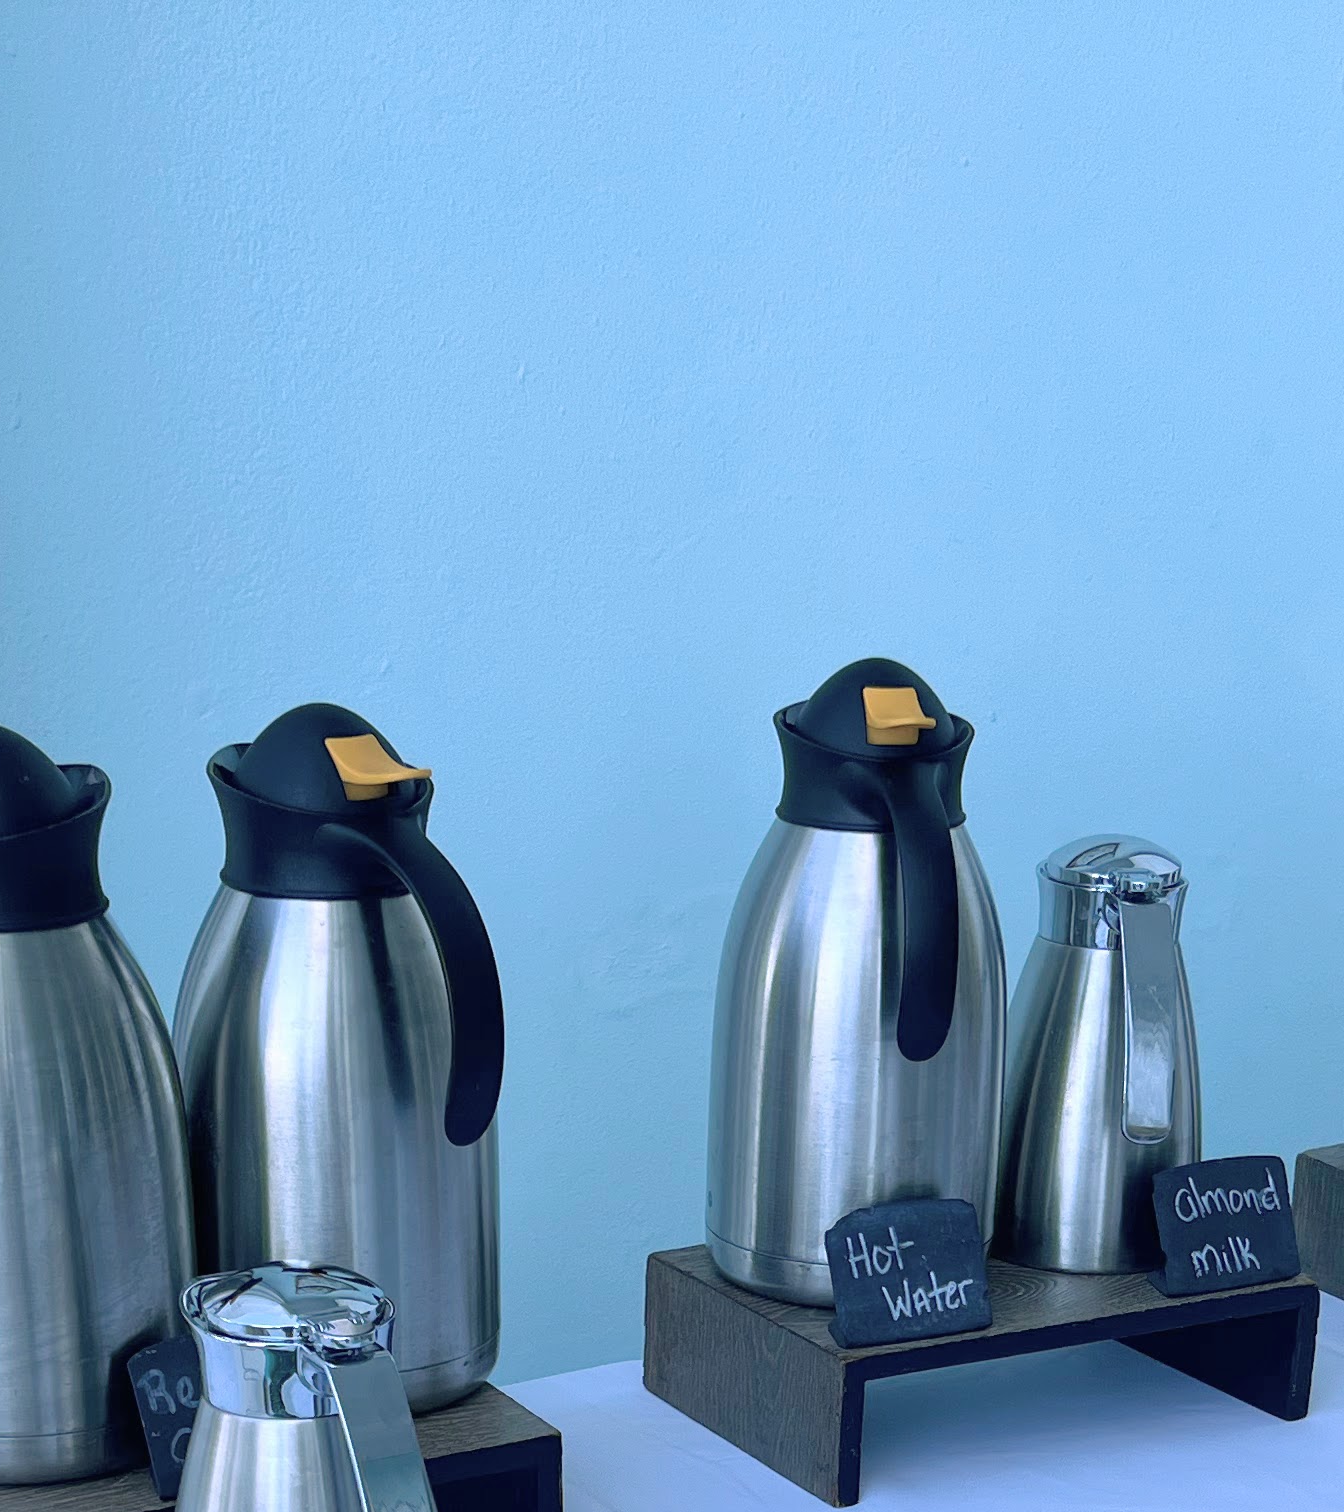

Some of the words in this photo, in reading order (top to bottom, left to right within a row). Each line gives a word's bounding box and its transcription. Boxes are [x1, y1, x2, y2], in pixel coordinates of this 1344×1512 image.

[1174, 1166, 1282, 1223] almond
[845, 1225, 915, 1280] Hot
[1190, 1236, 1261, 1279] milk
[136, 1368, 199, 1415] Re
